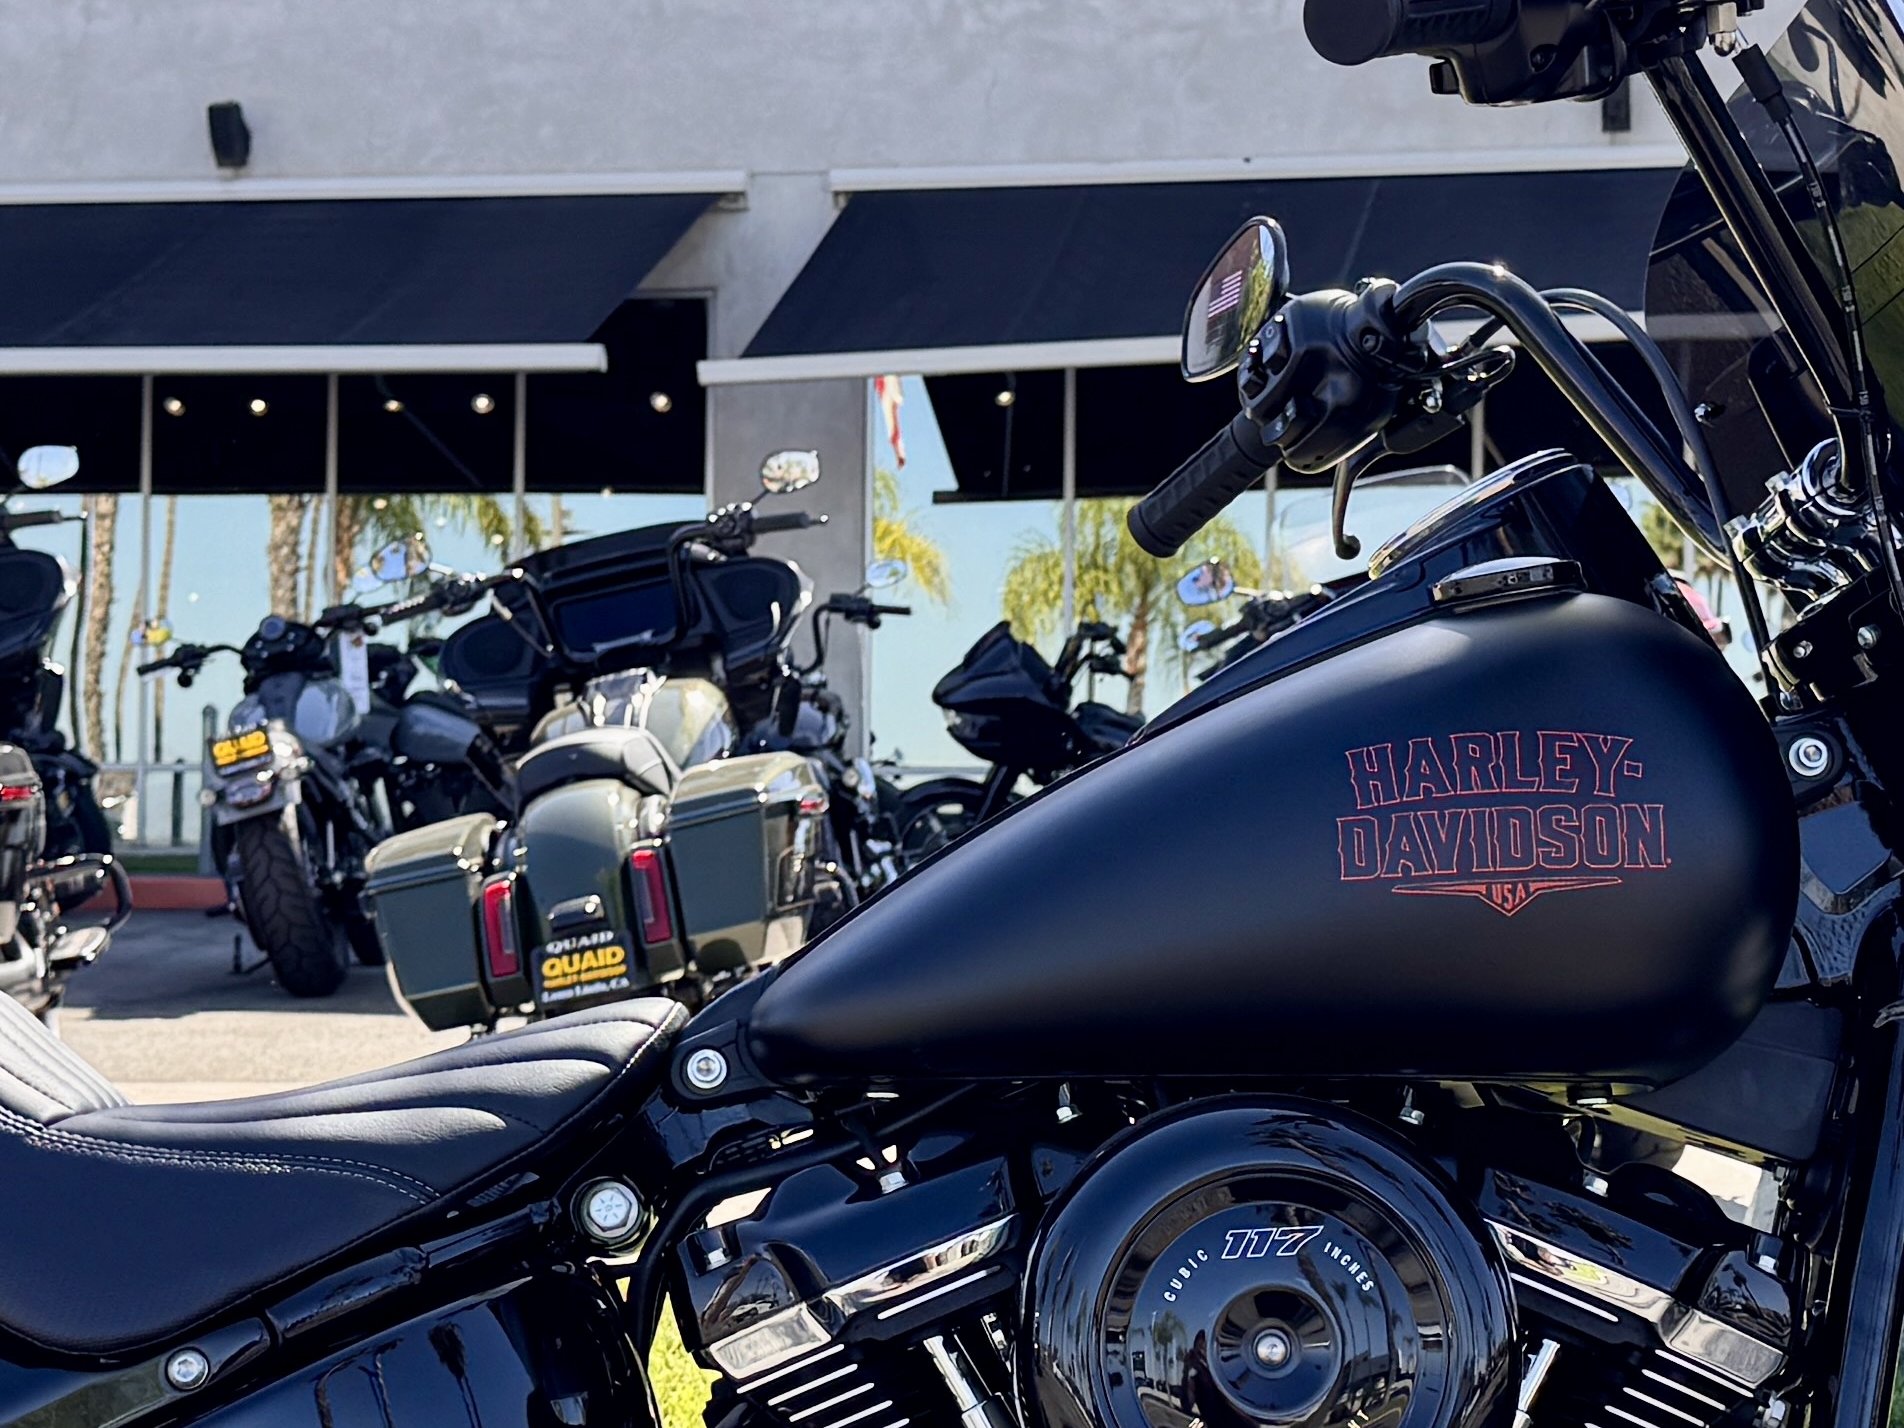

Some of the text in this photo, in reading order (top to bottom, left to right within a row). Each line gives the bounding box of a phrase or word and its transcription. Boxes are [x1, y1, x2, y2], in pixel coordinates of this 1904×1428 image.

[1346, 730, 1643, 809] HARLEY-
[1492, 882, 1527, 910] USA
[545, 930, 614, 955] QUAID
[542, 945, 625, 979] QUAID
[1163, 1224, 1376, 1303] CUBIC 117 INCHES
